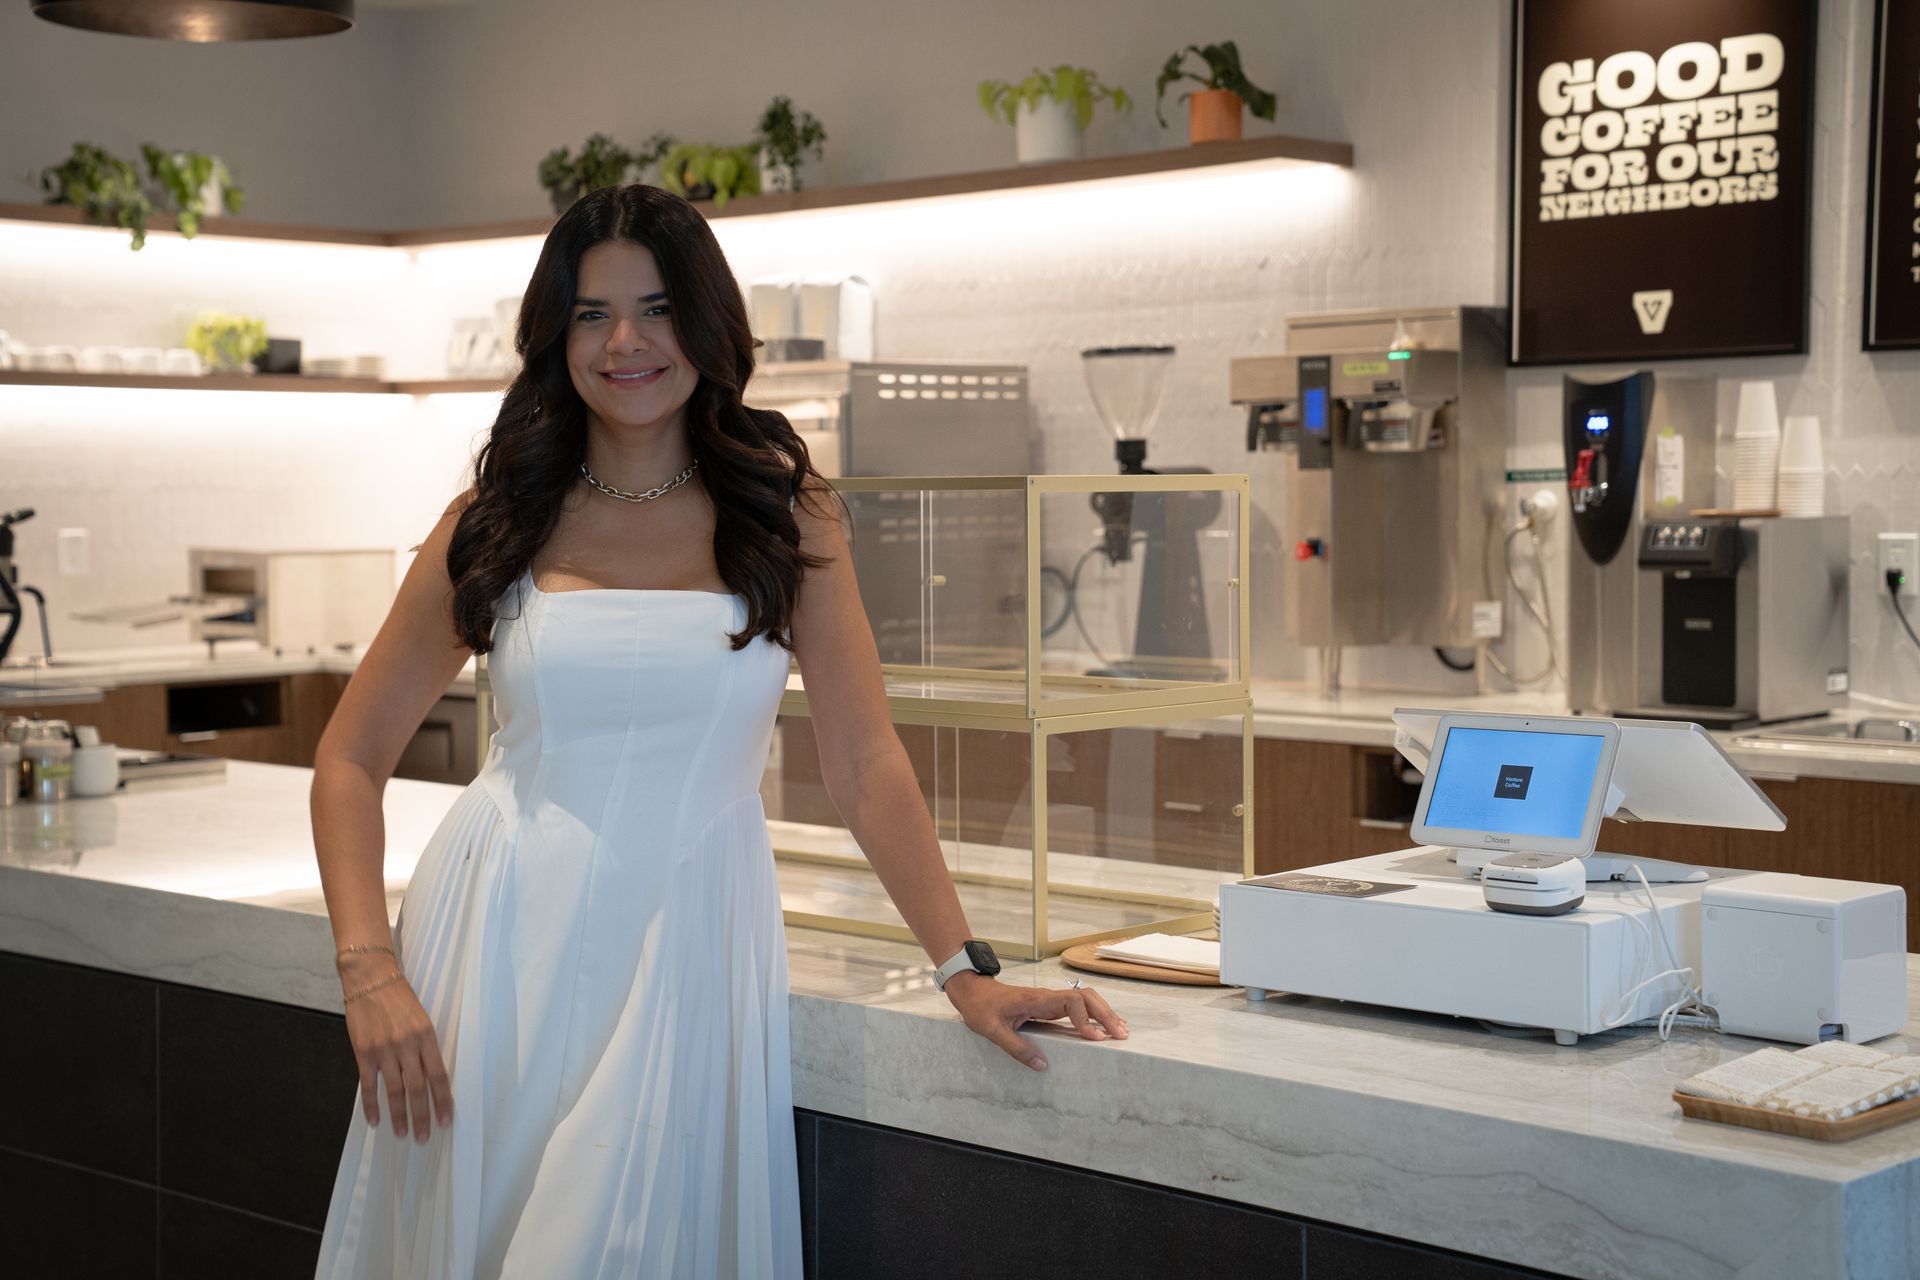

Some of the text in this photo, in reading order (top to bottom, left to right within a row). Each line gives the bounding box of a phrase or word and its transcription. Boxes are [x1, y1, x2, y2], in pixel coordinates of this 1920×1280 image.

[1538, 33, 1784, 116] GOOD
[1541, 89, 1779, 157] COFFEE
[1540, 134, 1779, 195] FOR OUR
[1539, 172, 1779, 222] NEIGHBORS
